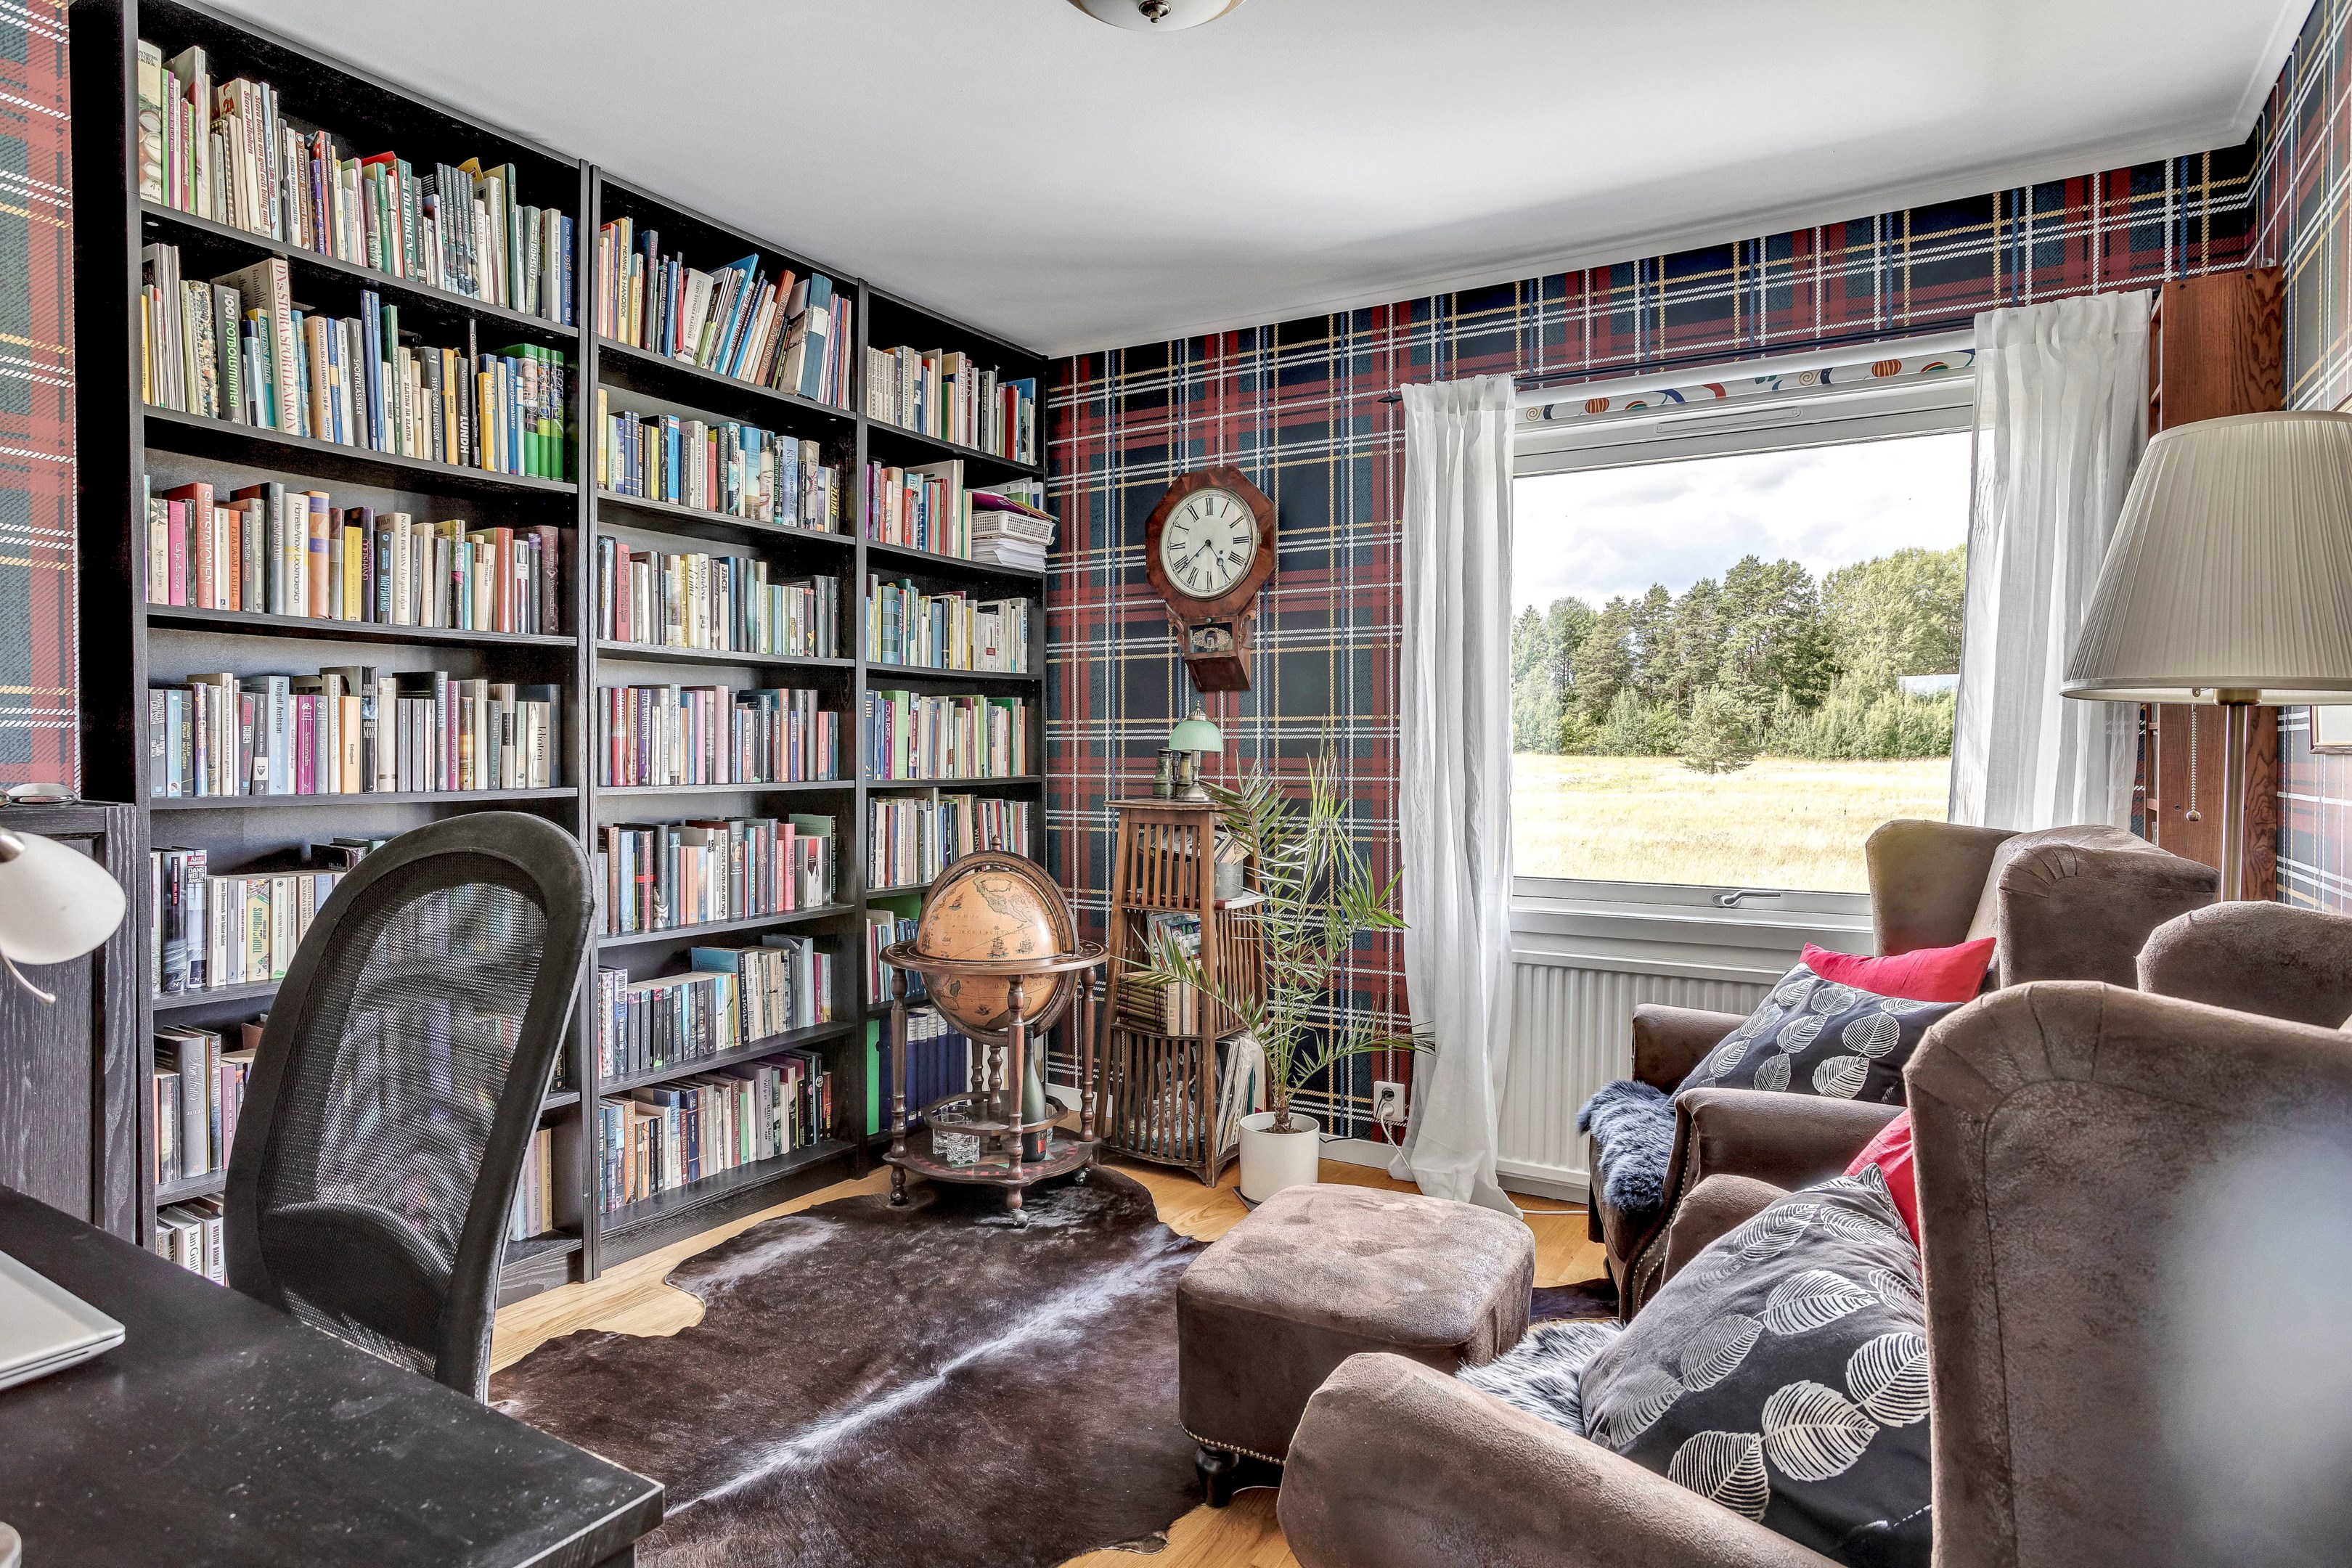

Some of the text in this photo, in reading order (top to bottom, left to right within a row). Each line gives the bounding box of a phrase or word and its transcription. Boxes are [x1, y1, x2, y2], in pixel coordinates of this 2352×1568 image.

[245, 115, 254, 155] Julboken
[256, 119, 265, 143] boken
[258, 144, 264, 156] om
[258, 158, 267, 172] god
[259, 189, 269, 209] billig
[403, 192, 413, 251] ÖLBOKEN
[744, 287, 754, 305] Stora
[730, 306, 748, 351] HOBBYBOKEN
[761, 290, 789, 369] HANDMADE SWEDEN
[224, 294, 240, 408] 1001 FOTBOLLSMINNEN
[260, 319, 272, 384] SPORTENS PÄRLOR
[275, 264, 296, 430] DN:s STORA SPORTLEXIKON
[354, 359, 363, 415] SPORTKLASSIKER
[405, 408, 411, 418] ÄR
[460, 416, 469, 454] LUNDH
[294, 502, 303, 529] Harriette
[1187, 505, 1199, 523] XI
[1205, 497, 1214, 516] XII
[199, 491, 212, 585] SLUTSTATIONEN
[1233, 536, 1249, 544] III
[293, 554, 302, 604] Dockmakerskan
[1187, 567, 1199, 587] VII
[1206, 571, 1213, 589] VI
[380, 575, 390, 611] MAFFIAKRIG
[275, 682, 284, 705] Majgull
[242, 725, 251, 744] COBEN
[536, 726, 546, 761] Idioten
